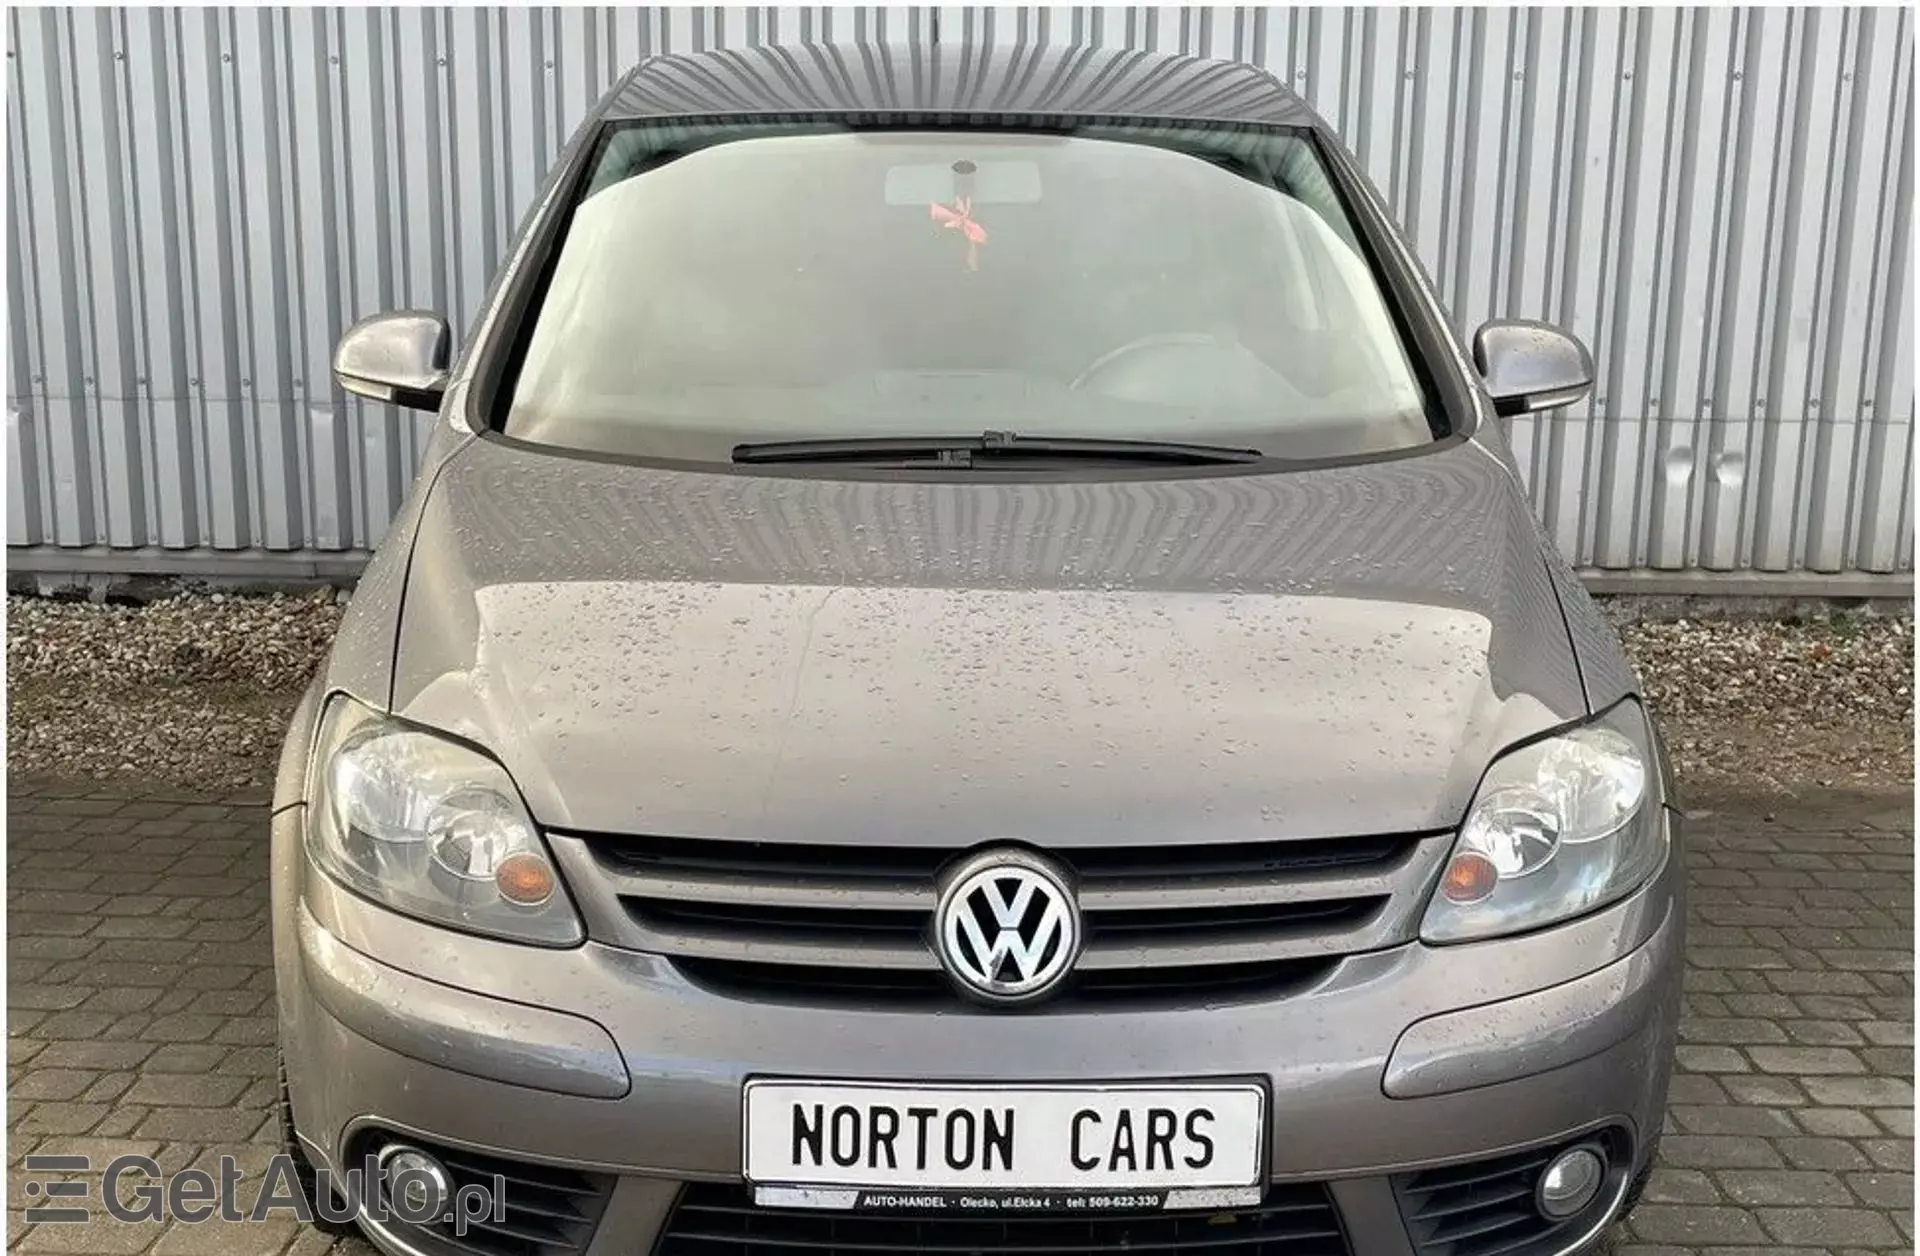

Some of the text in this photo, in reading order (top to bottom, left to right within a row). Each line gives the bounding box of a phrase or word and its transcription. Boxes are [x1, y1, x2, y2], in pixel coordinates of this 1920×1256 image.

[792, 1104, 1215, 1171] NORTON CARS
[863, 1195, 948, 1208] AUTO-HANDEL
[1088, 1195, 1159, 1208] 509-622-330
